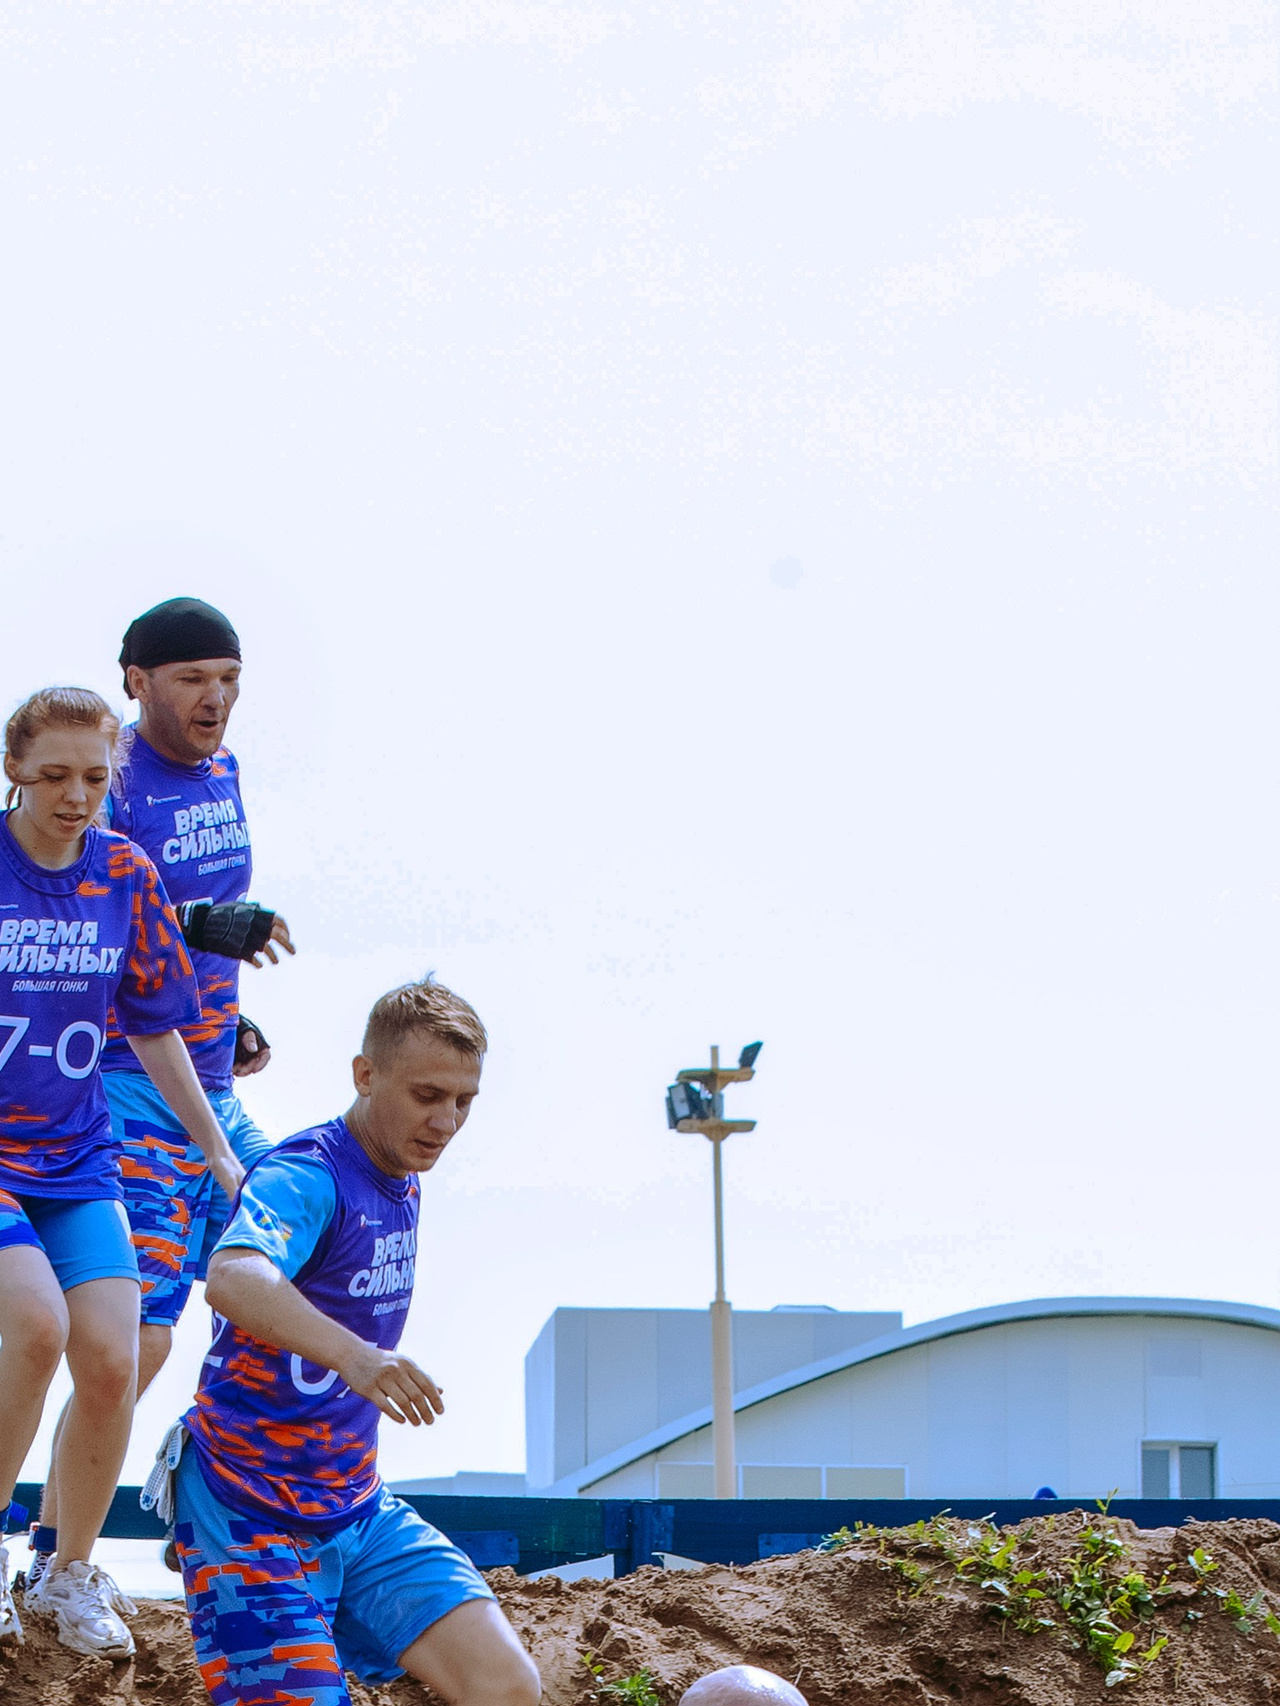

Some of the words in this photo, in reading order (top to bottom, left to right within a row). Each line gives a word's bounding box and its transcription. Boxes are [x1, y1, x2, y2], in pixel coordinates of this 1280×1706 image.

[174, 799, 238, 836] ВРЕМЯ
[162, 822, 251, 865] СИЛЬНЫ
[12, 981, 57, 992] БОЛЬШАЯ
[57, 981, 89, 993] ГОНКА
[371, 1228, 416, 1268] ВРЕМ
[348, 1257, 415, 1298] СИЛЬН
